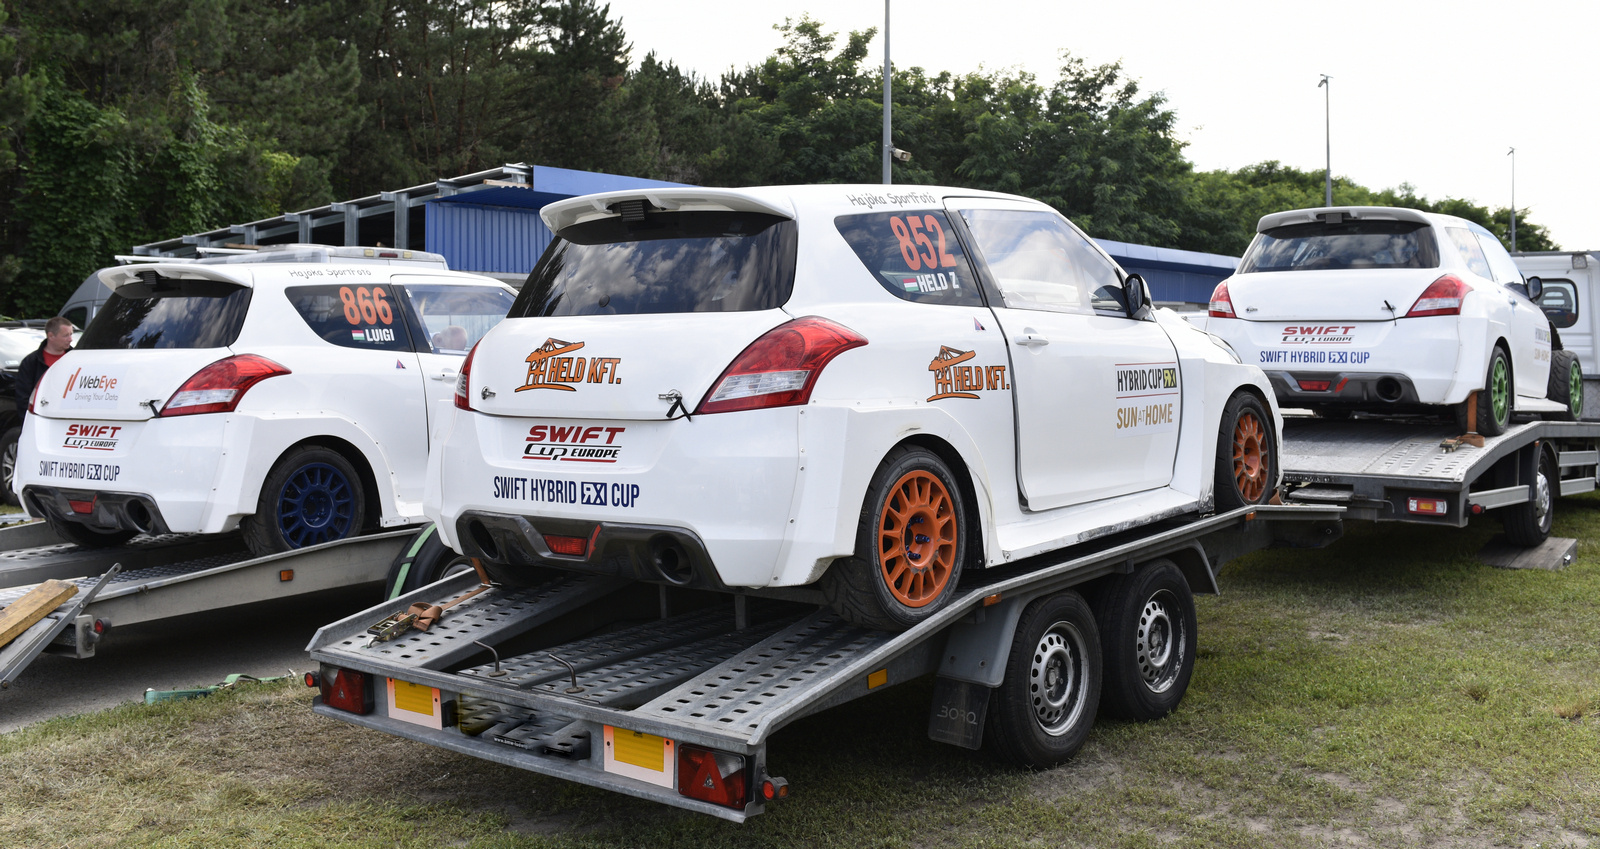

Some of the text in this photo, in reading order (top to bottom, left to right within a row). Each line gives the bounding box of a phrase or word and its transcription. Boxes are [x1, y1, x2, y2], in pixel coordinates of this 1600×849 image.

[890, 214, 957, 271] 852
[916, 271, 960, 293] HELD Z
[339, 286, 393, 325] 866
[365, 328, 395, 342] LUIGI
[1282, 326, 1356, 335] SWIFT
[1260, 350, 1288, 363] SWIFT
[1290, 351, 1326, 363] HYBRID
[1350, 351, 1370, 364] CUP
[547, 357, 622, 384] HELD KFT.
[953, 365, 1010, 391] HELD KFT.
[1117, 370, 1147, 392] HYBRID
[1148, 369, 1162, 389] CUP
[79, 375, 118, 392] WebEye
[75, 392, 119, 402] Driving Your Data
[1116, 406, 1138, 430] SUN
[1145, 403, 1173, 426] HOME
[66, 424, 122, 438] SWIFT
[525, 425, 626, 444] SWIFT
[570, 448, 621, 459] EUROPE
[39, 461, 58, 477] SWIFT
[59, 462, 86, 479] HYBRID
[103, 464, 120, 481] CUP
[493, 475, 527, 500] SWIFT
[531, 478, 577, 504] HYBRID
[611, 482, 640, 508] CUP
